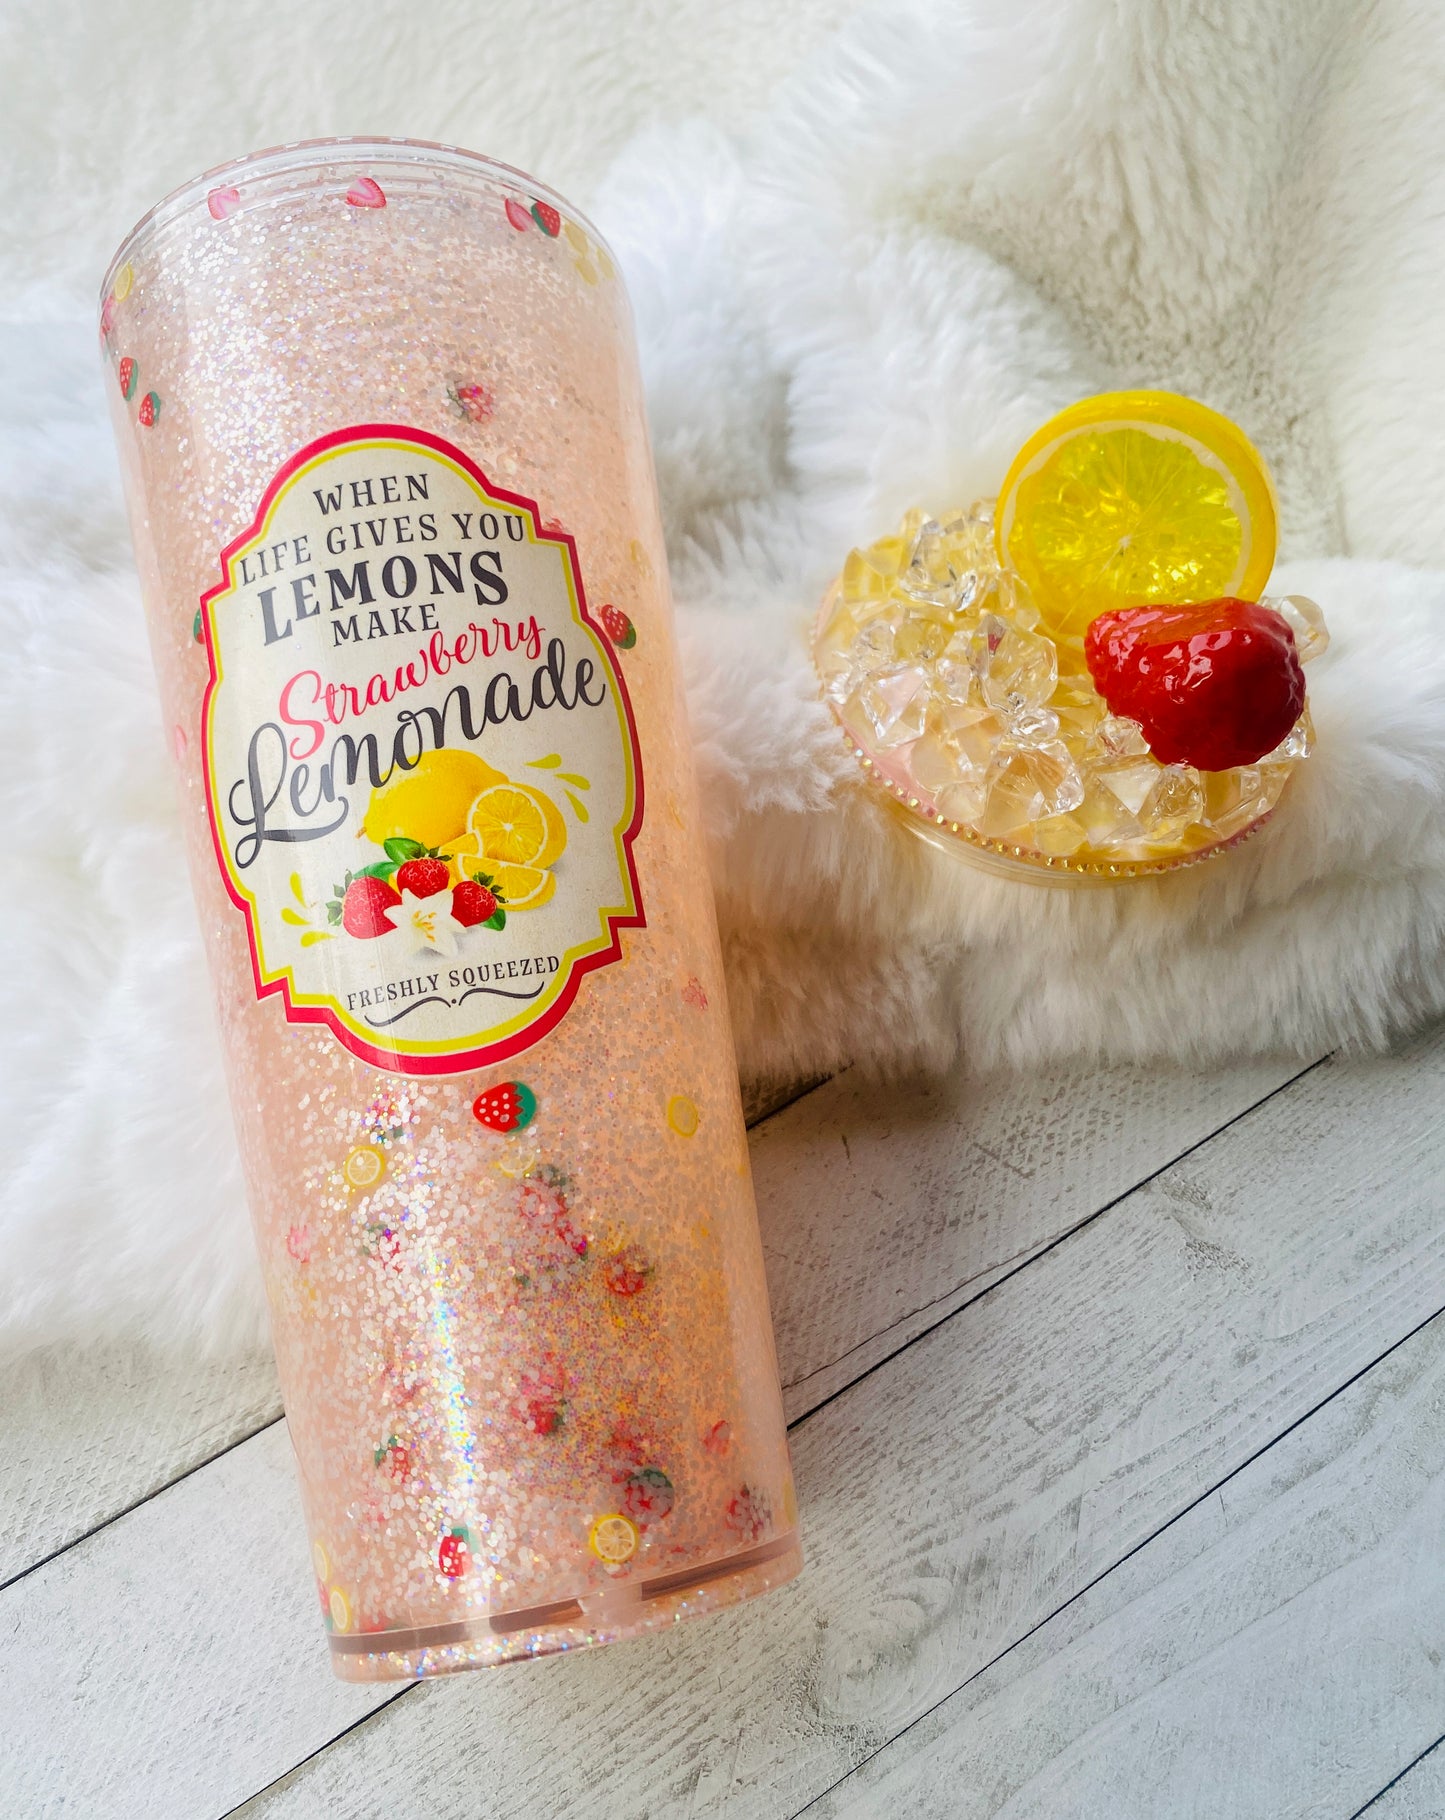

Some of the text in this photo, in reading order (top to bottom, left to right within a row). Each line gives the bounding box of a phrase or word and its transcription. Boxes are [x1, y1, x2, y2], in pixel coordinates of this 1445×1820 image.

[313, 473, 429, 515] WHEN
[240, 513, 525, 586] LIFE GIVES YOU
[257, 551, 509, 646] LEMONS
[331, 603, 440, 646] MAKE
[279, 615, 546, 760] Strawberry
[229, 637, 606, 869] Lemonade
[347, 955, 560, 1011] FRESHLY SQUEEZED
